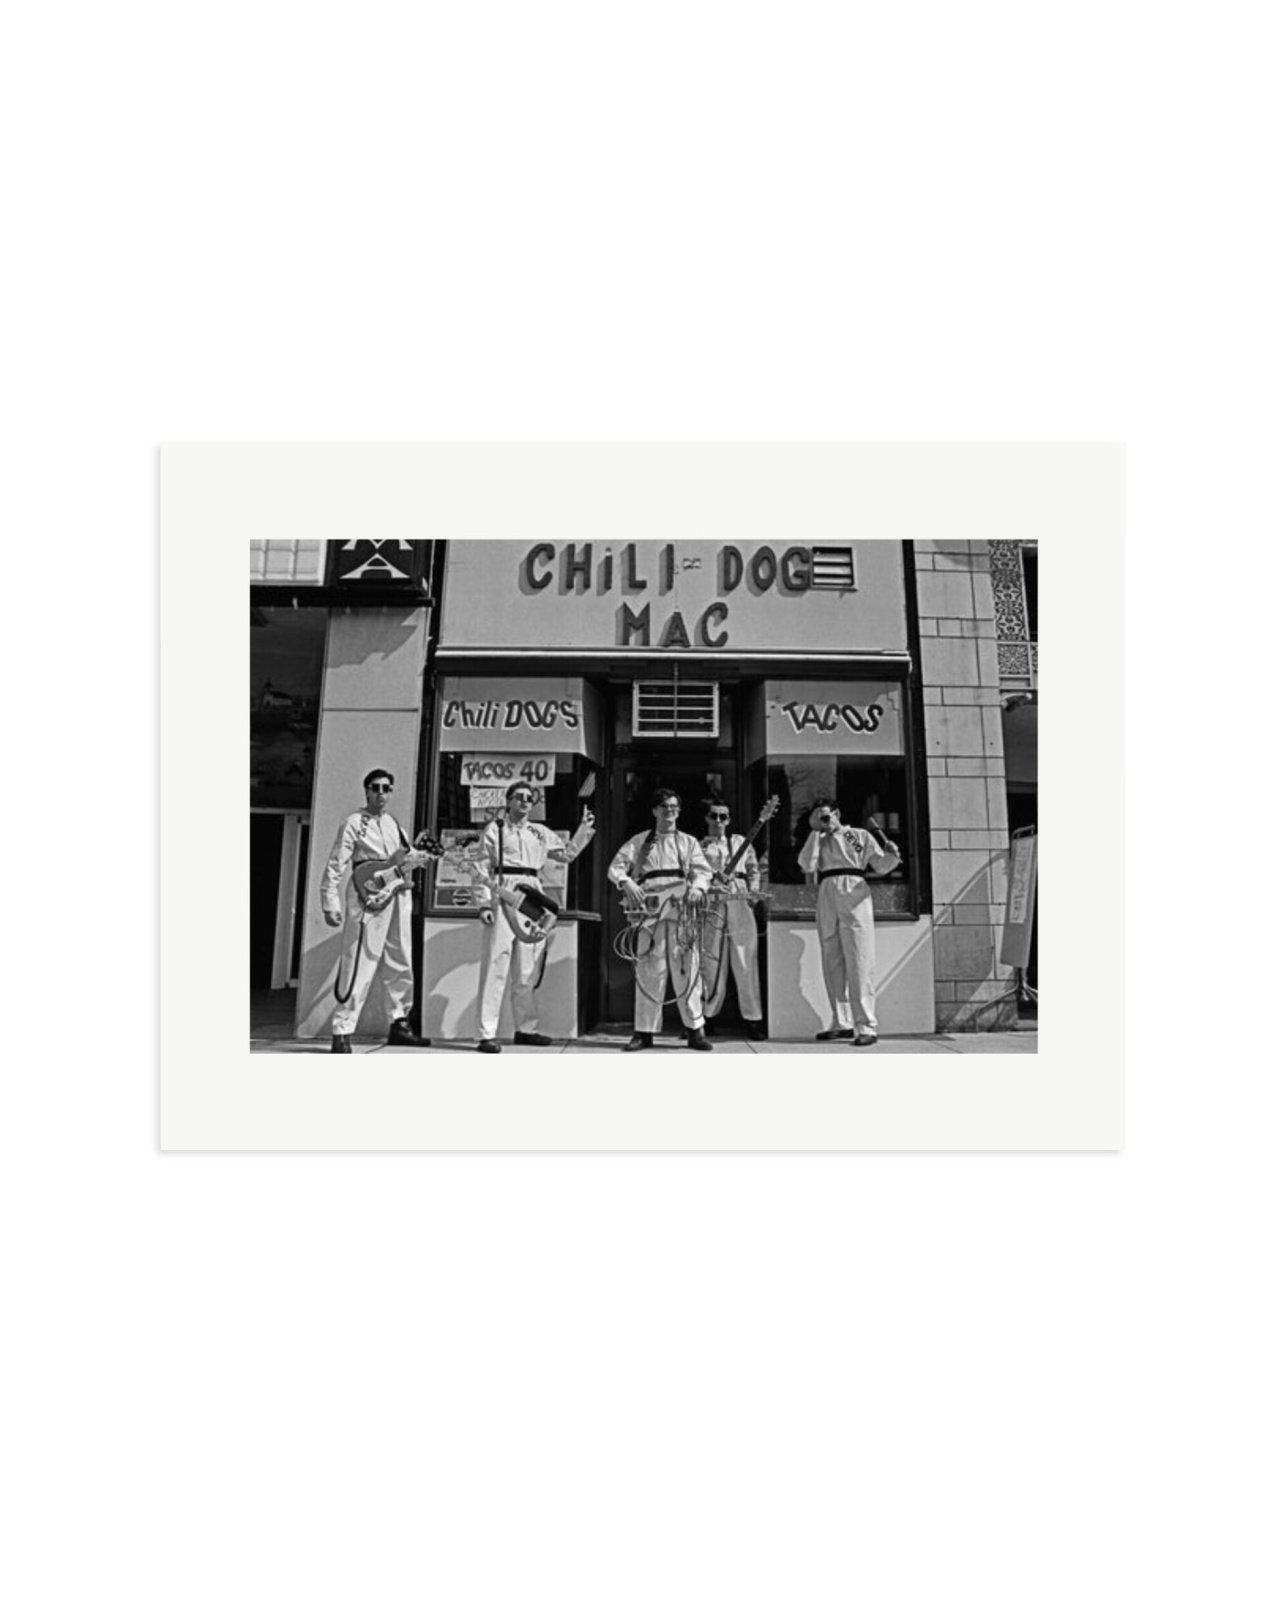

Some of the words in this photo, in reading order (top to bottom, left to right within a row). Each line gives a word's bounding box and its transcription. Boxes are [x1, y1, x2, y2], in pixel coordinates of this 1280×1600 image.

[619, 600, 729, 647] MAC
[443, 700, 499, 728] Chili
[503, 700, 579, 729] DOGS
[781, 701, 884, 732] TACOS
[464, 761, 516, 781] TACOS
[843, 830, 864, 852] DEVO
